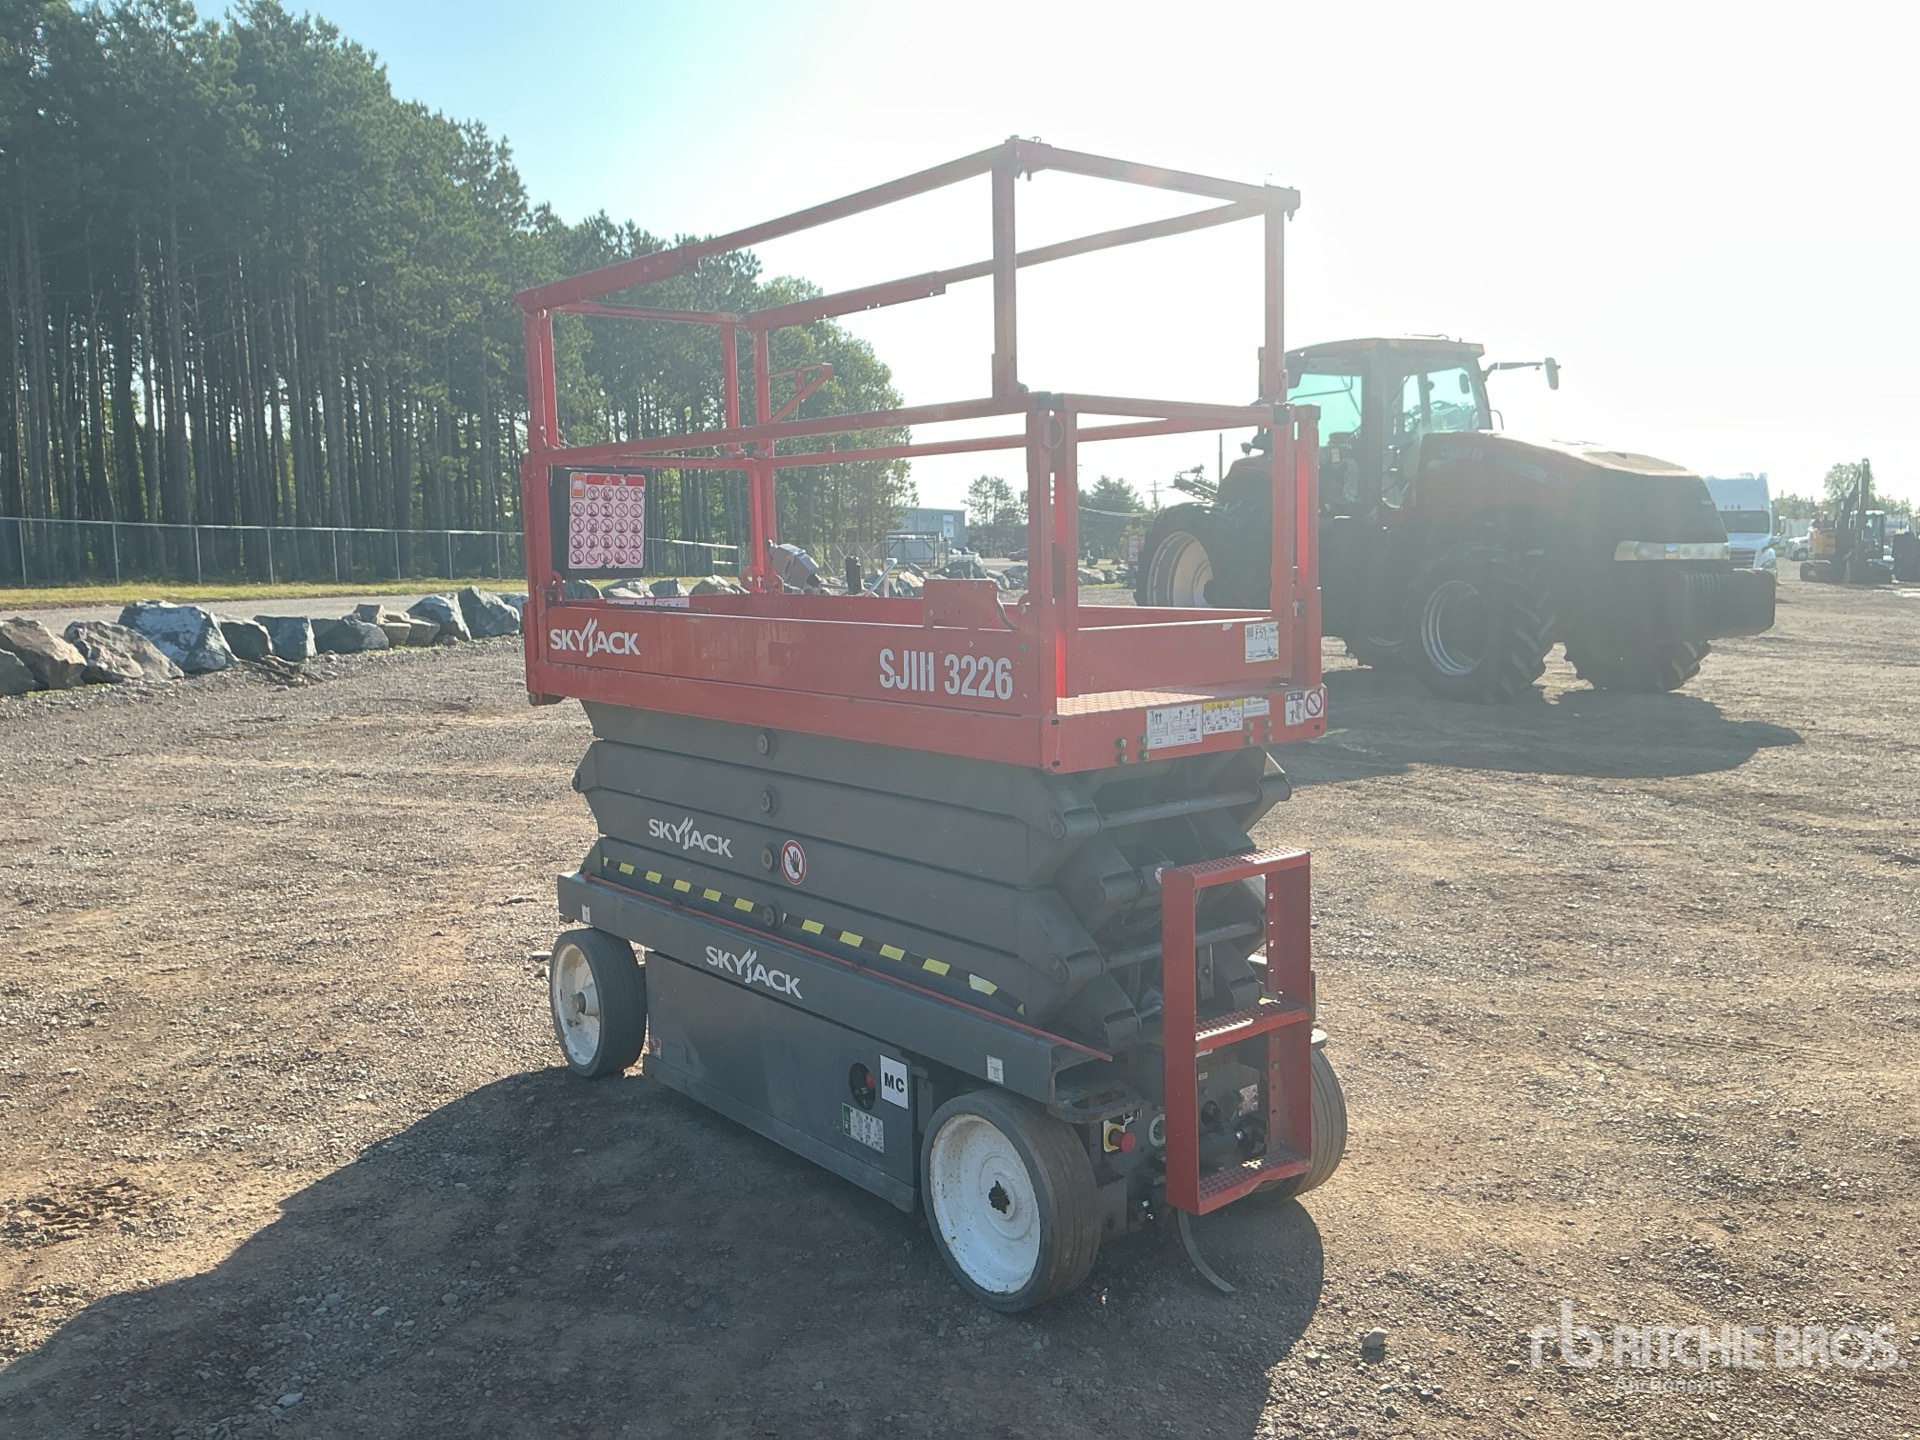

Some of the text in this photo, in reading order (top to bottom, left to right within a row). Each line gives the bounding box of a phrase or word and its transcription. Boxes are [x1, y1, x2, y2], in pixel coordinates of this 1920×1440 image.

[550, 617, 641, 658] SKYJACK
[879, 648, 1013, 700] SJIII 3226
[648, 816, 733, 859] SKYJACK
[705, 945, 803, 1000] SKYJACK
[884, 1071, 905, 1093] MC
